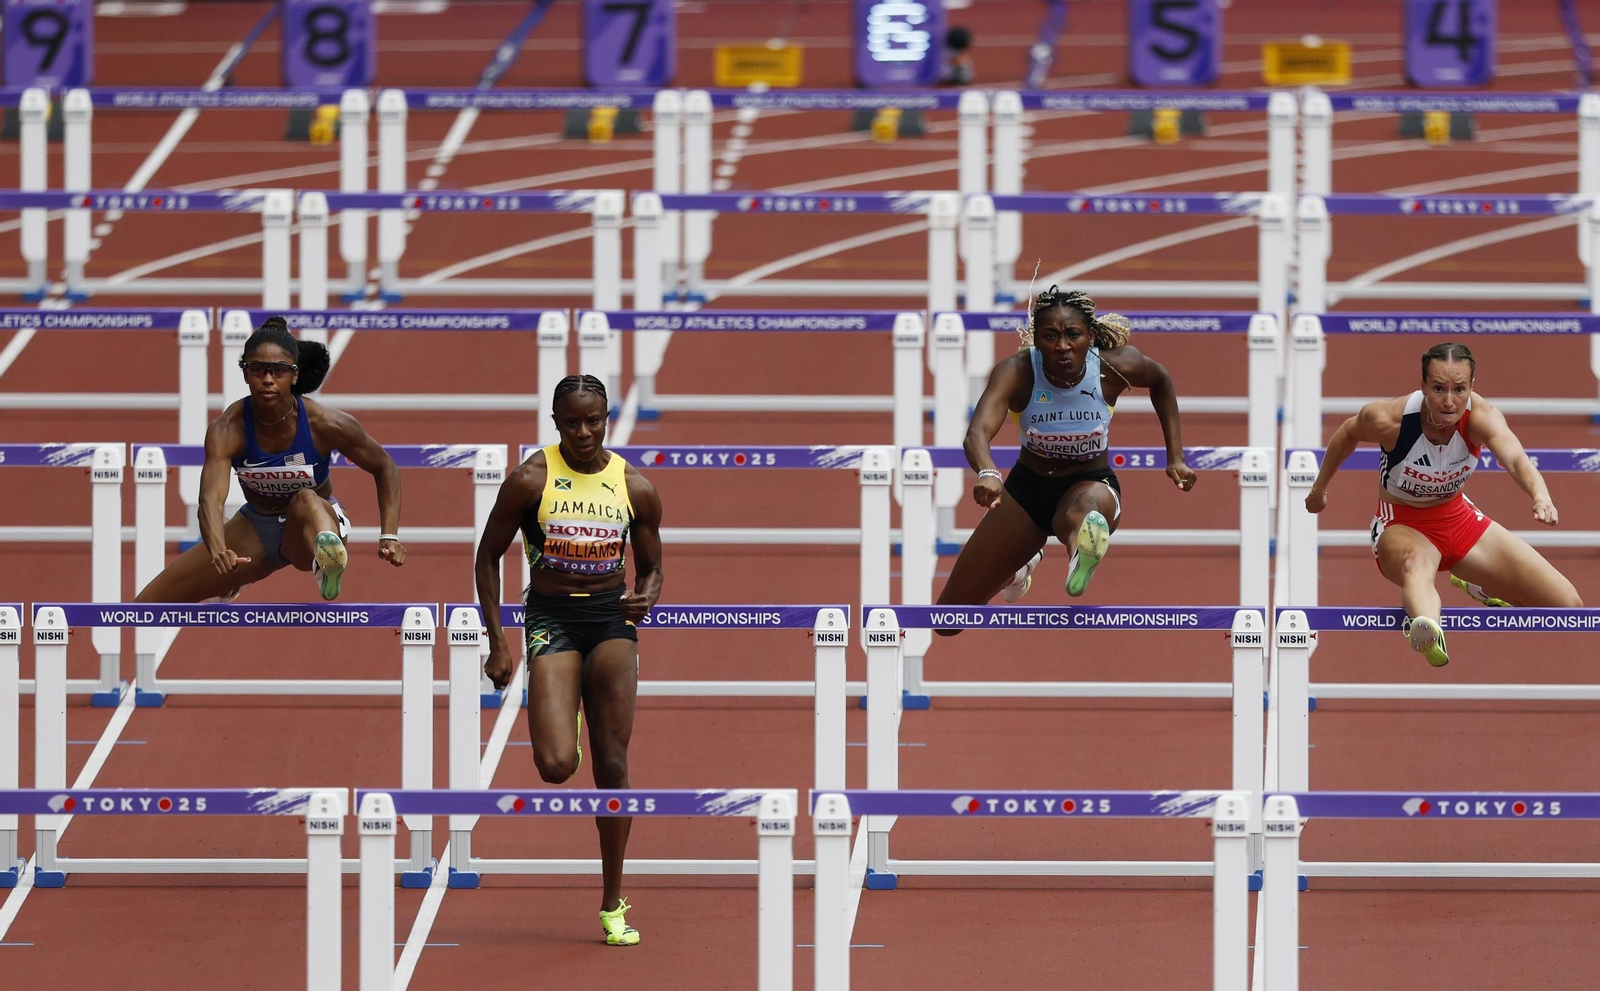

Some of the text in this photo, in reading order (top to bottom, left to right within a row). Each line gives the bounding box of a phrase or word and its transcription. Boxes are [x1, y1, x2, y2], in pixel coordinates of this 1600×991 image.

[304, 5, 350, 68] 8
[602, 2, 650, 65] 7
[867, 0, 931, 62] 6
[1149, 0, 1200, 62] 5
[1424, 0, 1481, 63] 4
[23, 9, 70, 74] 9
[44, 315, 152, 328] CHAMPIONSHIPS
[328, 315, 398, 328] ATHLETICS
[401, 315, 509, 329] CHAMPIONSHIPS
[634, 316, 866, 330] WORLD ATHLETICS CHAMPIONSHIPS
[988, 317, 1030, 330] WORL
[1349, 319, 1581, 332] WORLD ATHLETICS CHAMPIONSHIPS
[1031, 411, 1102, 424] SAINT LUCIA
[1029, 431, 1103, 442] HONDA
[1031, 438, 1101, 454] LAURENCIN
[95, 470, 119, 480] NISHI
[137, 470, 163, 480] NISHI
[476, 471, 502, 481] NISHI
[863, 472, 888, 482] NISHI
[904, 472, 929, 482] NISHI
[1242, 474, 1268, 484] NISHI
[1290, 474, 1316, 484] NISHI
[1402, 464, 1471, 484] HONDA
[250, 480, 313, 492] OHNSON
[549, 501, 624, 522] JAMAICA
[548, 524, 619, 538] HONDA
[549, 541, 619, 559] WILLIAMS
[101, 611, 369, 624] WORLD ATHLETICS CHAMPIONSHIPS
[657, 612, 781, 625] CHAMPIONSHIPS
[931, 613, 1199, 627] WORLD ATHLETICS CHAMPIONSHIPS
[1343, 615, 1396, 629] WORLD
[37, 632, 64, 640] NISHI
[407, 632, 433, 640] NISHI
[452, 633, 479, 641] NISHI
[817, 634, 844, 642] NISHI
[869, 634, 895, 642] NISHI
[1235, 635, 1261, 643] NISHI
[1279, 636, 1306, 644] NISHI
[310, 820, 339, 830] NISHI
[363, 820, 392, 830] NISHI
[761, 821, 789, 831] NISHI
[818, 822, 846, 832] NISHI
[1216, 823, 1245, 833] NISHI
[1266, 823, 1294, 833] NISHI
